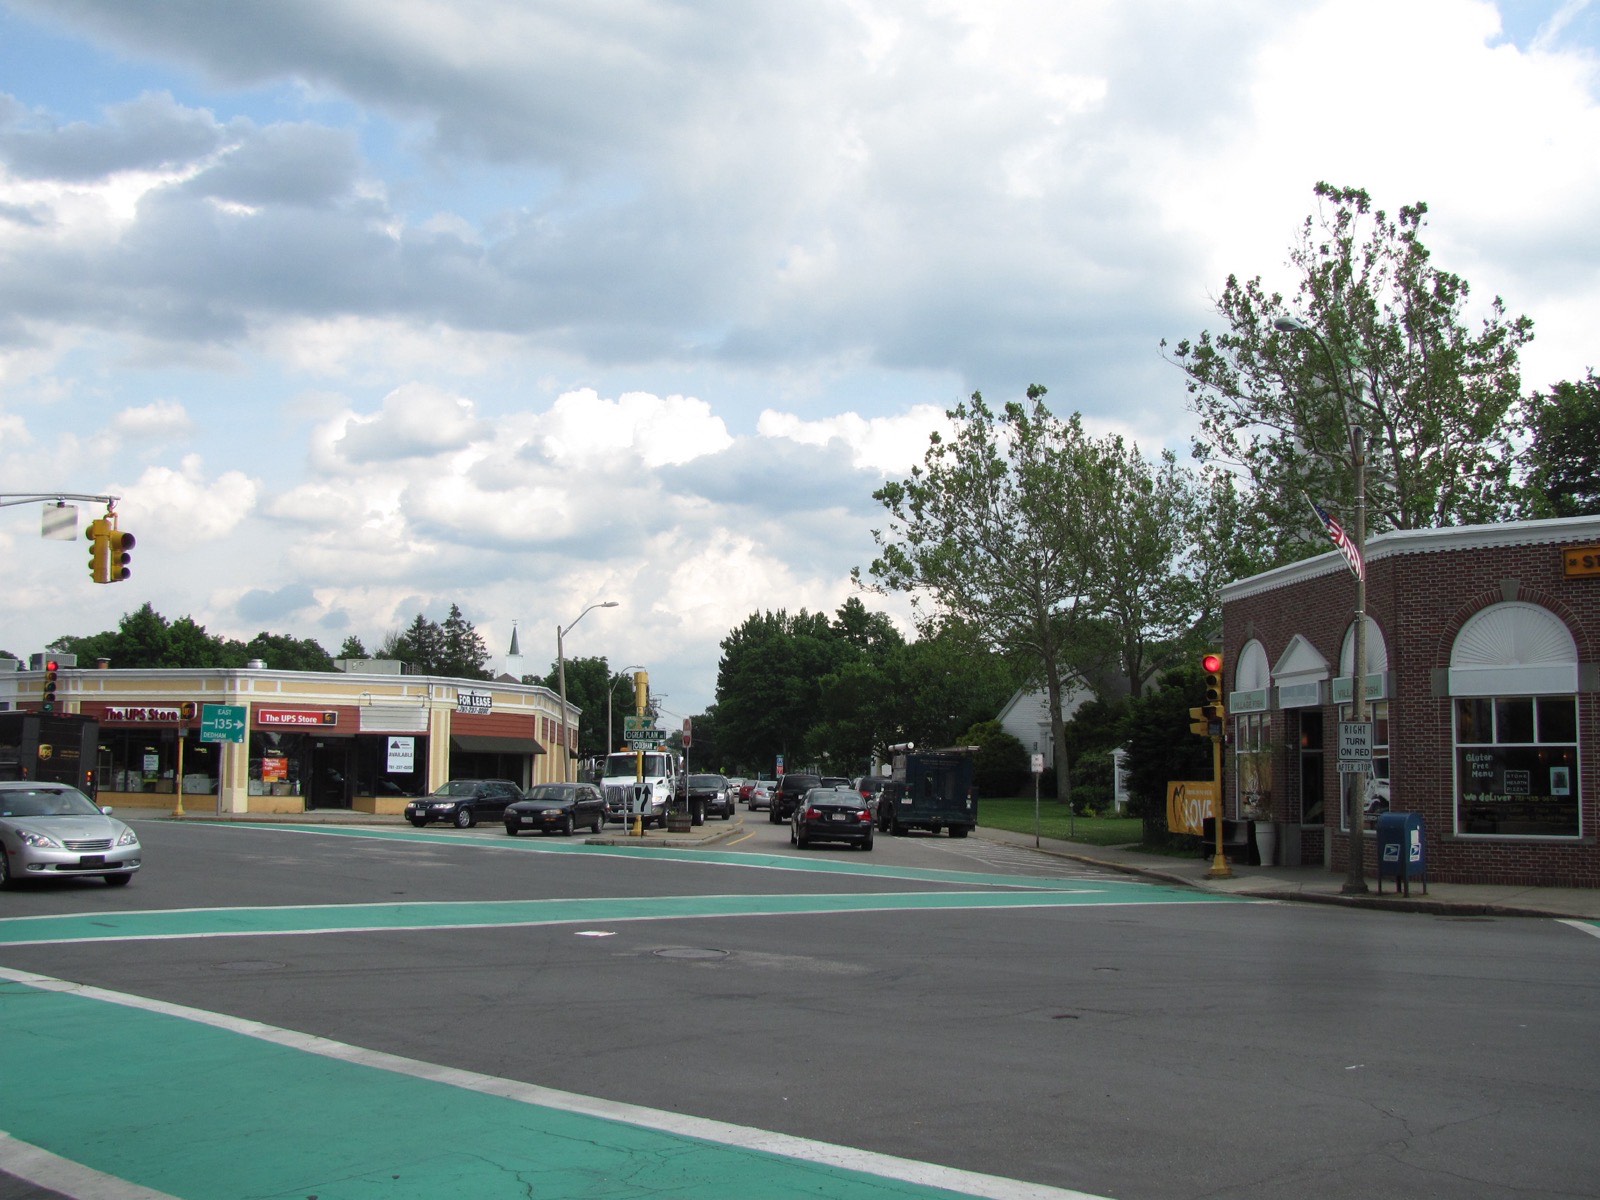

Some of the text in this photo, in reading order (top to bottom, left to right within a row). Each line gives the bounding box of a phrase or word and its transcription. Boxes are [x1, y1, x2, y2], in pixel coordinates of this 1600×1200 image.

[459, 695, 491, 707] FOR LEASE
[105, 708, 178, 720] The UPS Store
[266, 714, 279, 722] The
[281, 715, 296, 723] UPS
[298, 715, 317, 723] Store
[214, 718, 233, 729] 135
[1344, 725, 1366, 734] RIGHT
[1345, 737, 1366, 745] TURN
[1340, 748, 1370, 756] ON RED
[1465, 753, 1493, 762] Gluten
[1338, 763, 1372, 771] AFTER STOP
[1463, 793, 1477, 801] We
